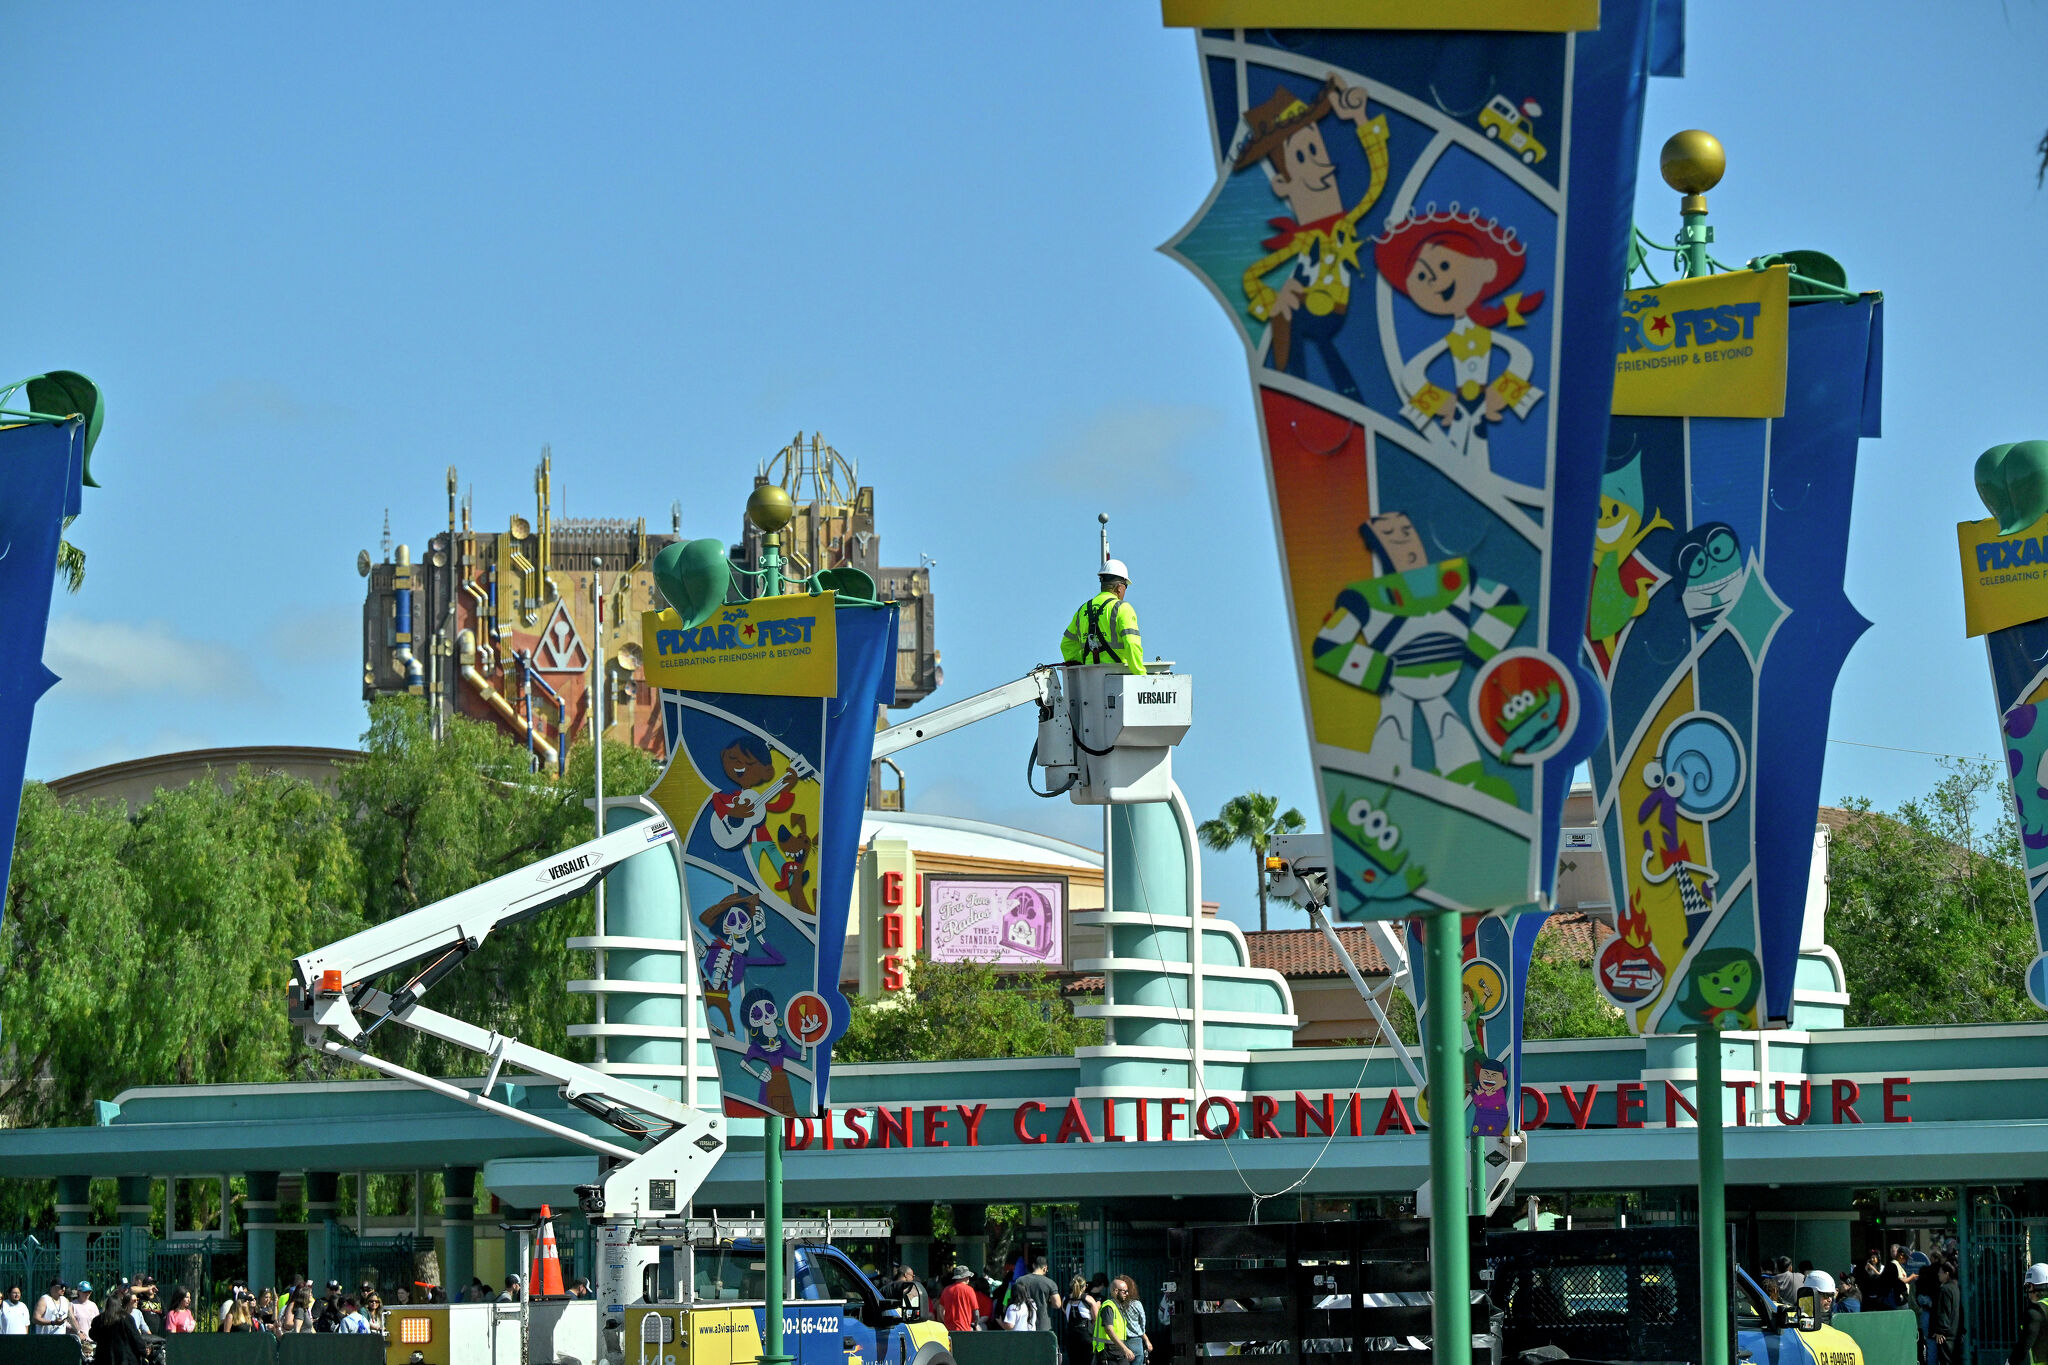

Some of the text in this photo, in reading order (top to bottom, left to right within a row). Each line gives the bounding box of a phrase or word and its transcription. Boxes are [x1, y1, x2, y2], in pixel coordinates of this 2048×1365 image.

[1672, 302, 1761, 348] FEST
[1617, 346, 1753, 373] FRIENDSHIP & BEYOND
[1980, 571, 2040, 586] CELEBRATING
[722, 608, 749, 623] 2024
[656, 616, 816, 655] PIXAR FEST
[660, 646, 812, 669] CELEBRATING FRIENDSHIP & BEYOND
[1137, 691, 1177, 705] VERSALIFT
[548, 854, 590, 880] VERSALIFT
[883, 871, 904, 991] GAS
[942, 908, 992, 943] Radios
[973, 927, 989, 935] THE
[960, 935, 997, 945] STANDARD
[785, 1077, 1912, 1150] DISNEY CALIFORNIA DVENTURE
